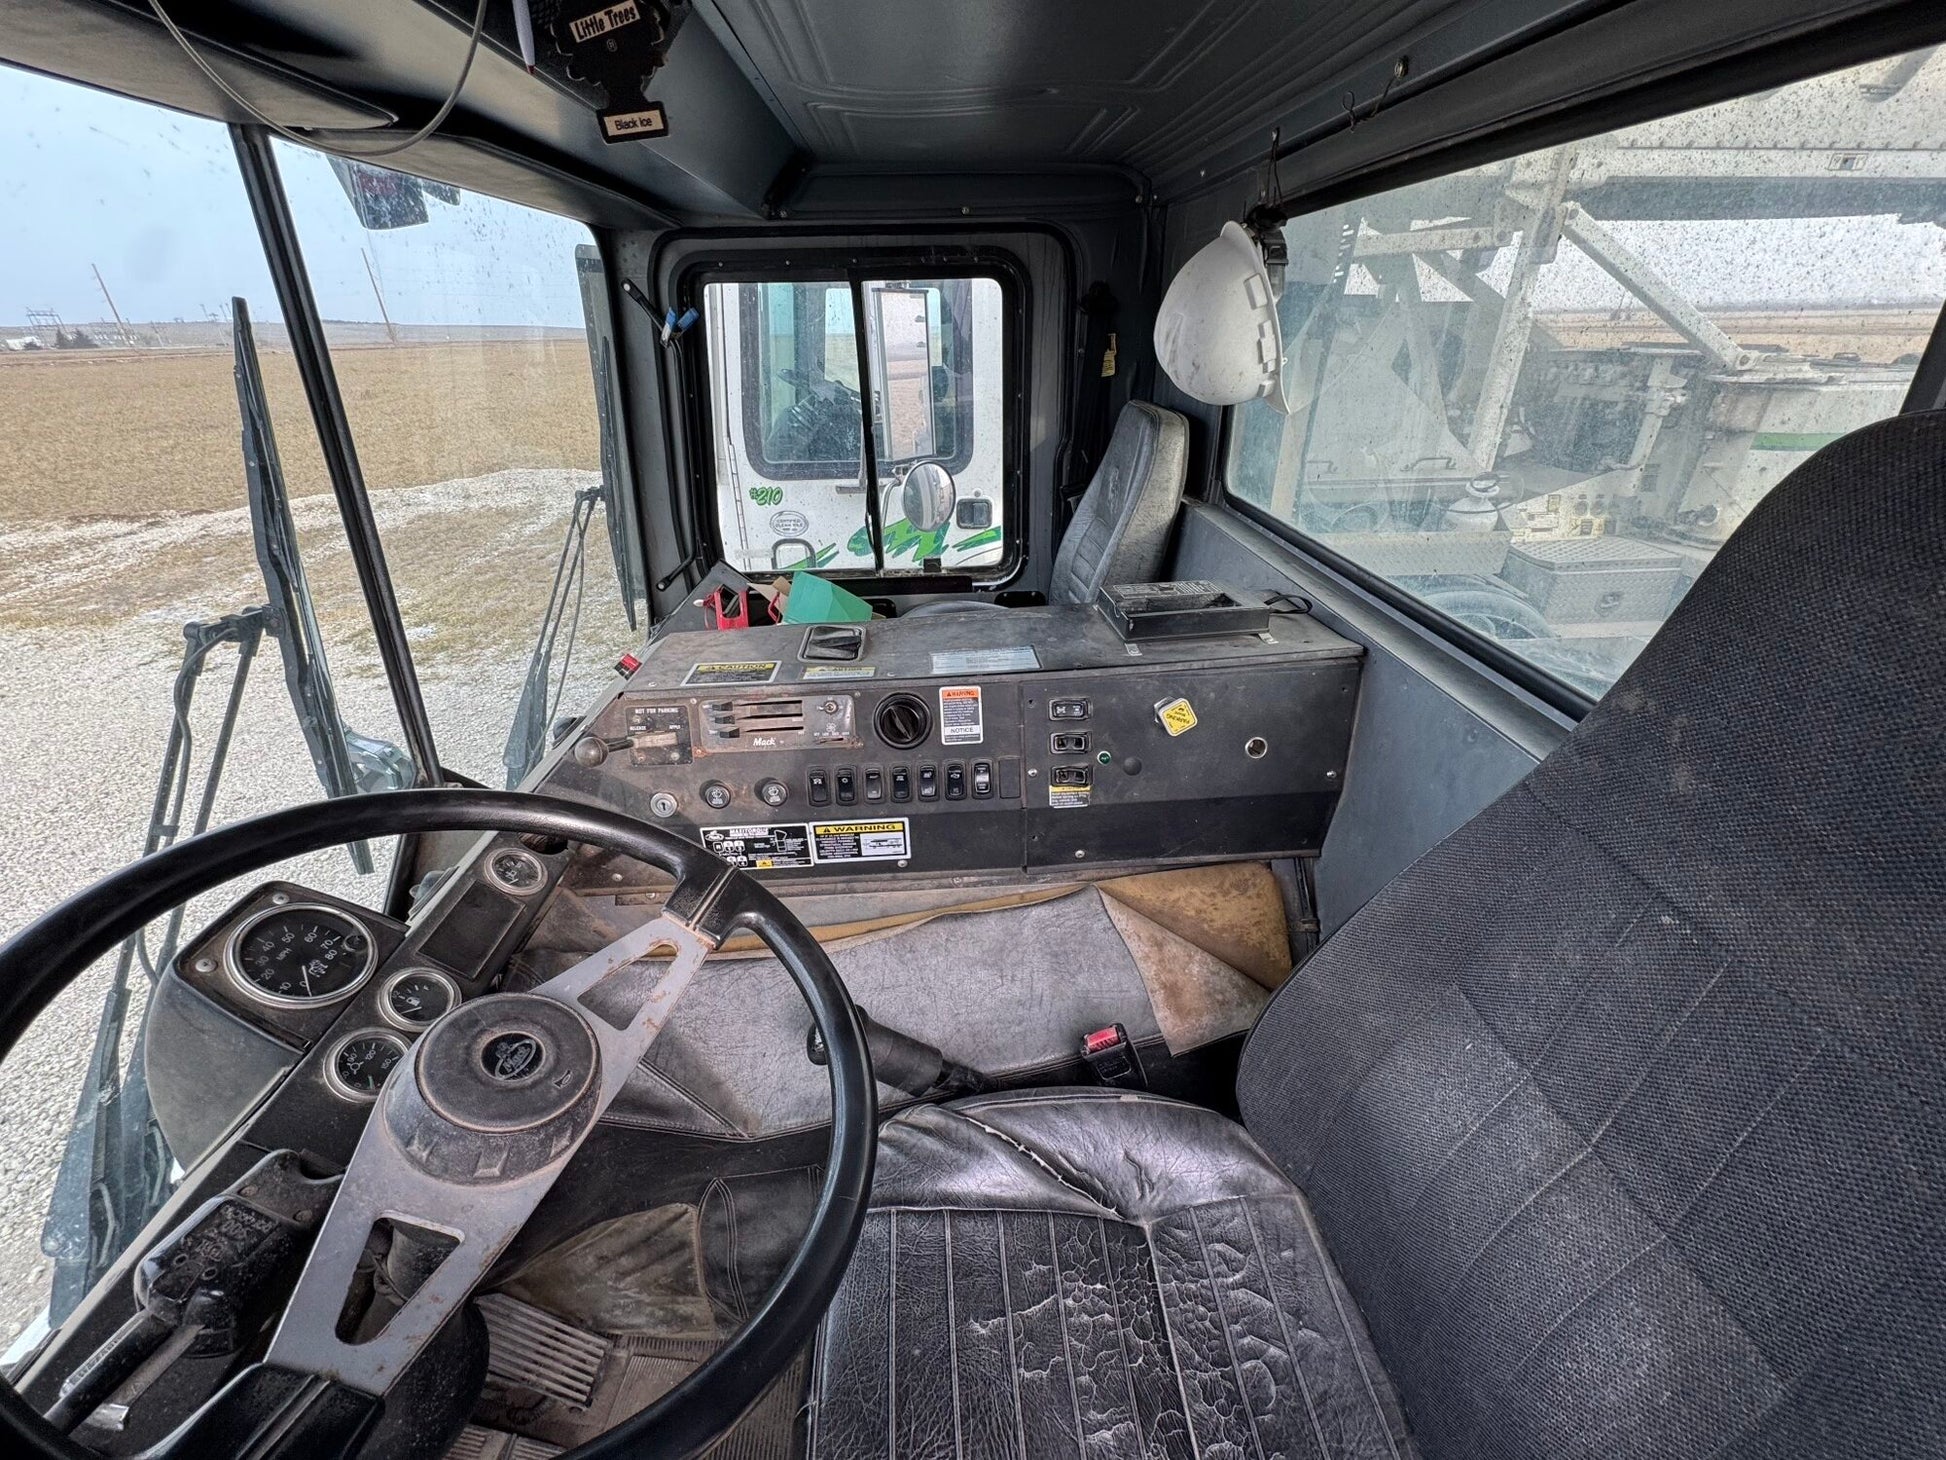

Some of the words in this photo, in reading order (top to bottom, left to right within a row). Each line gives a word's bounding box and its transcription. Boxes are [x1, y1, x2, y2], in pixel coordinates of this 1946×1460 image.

[574, 15, 606, 41] Little
[604, 6, 636, 28] Trees
[614, 118, 639, 131] Black
[639, 117, 653, 128] Ice
[749, 486, 784, 506] #210
[753, 737, 777, 747] Mack
[833, 823, 896, 833] WARNING
[281, 932, 295, 944] 50
[304, 932, 318, 944] 60
[262, 941, 275, 952] 40
[320, 939, 334, 950] 70
[276, 947, 293, 961] MPH
[324, 949, 338, 961] 80
[261, 968, 275, 980] 20
[280, 981, 292, 991] 10
